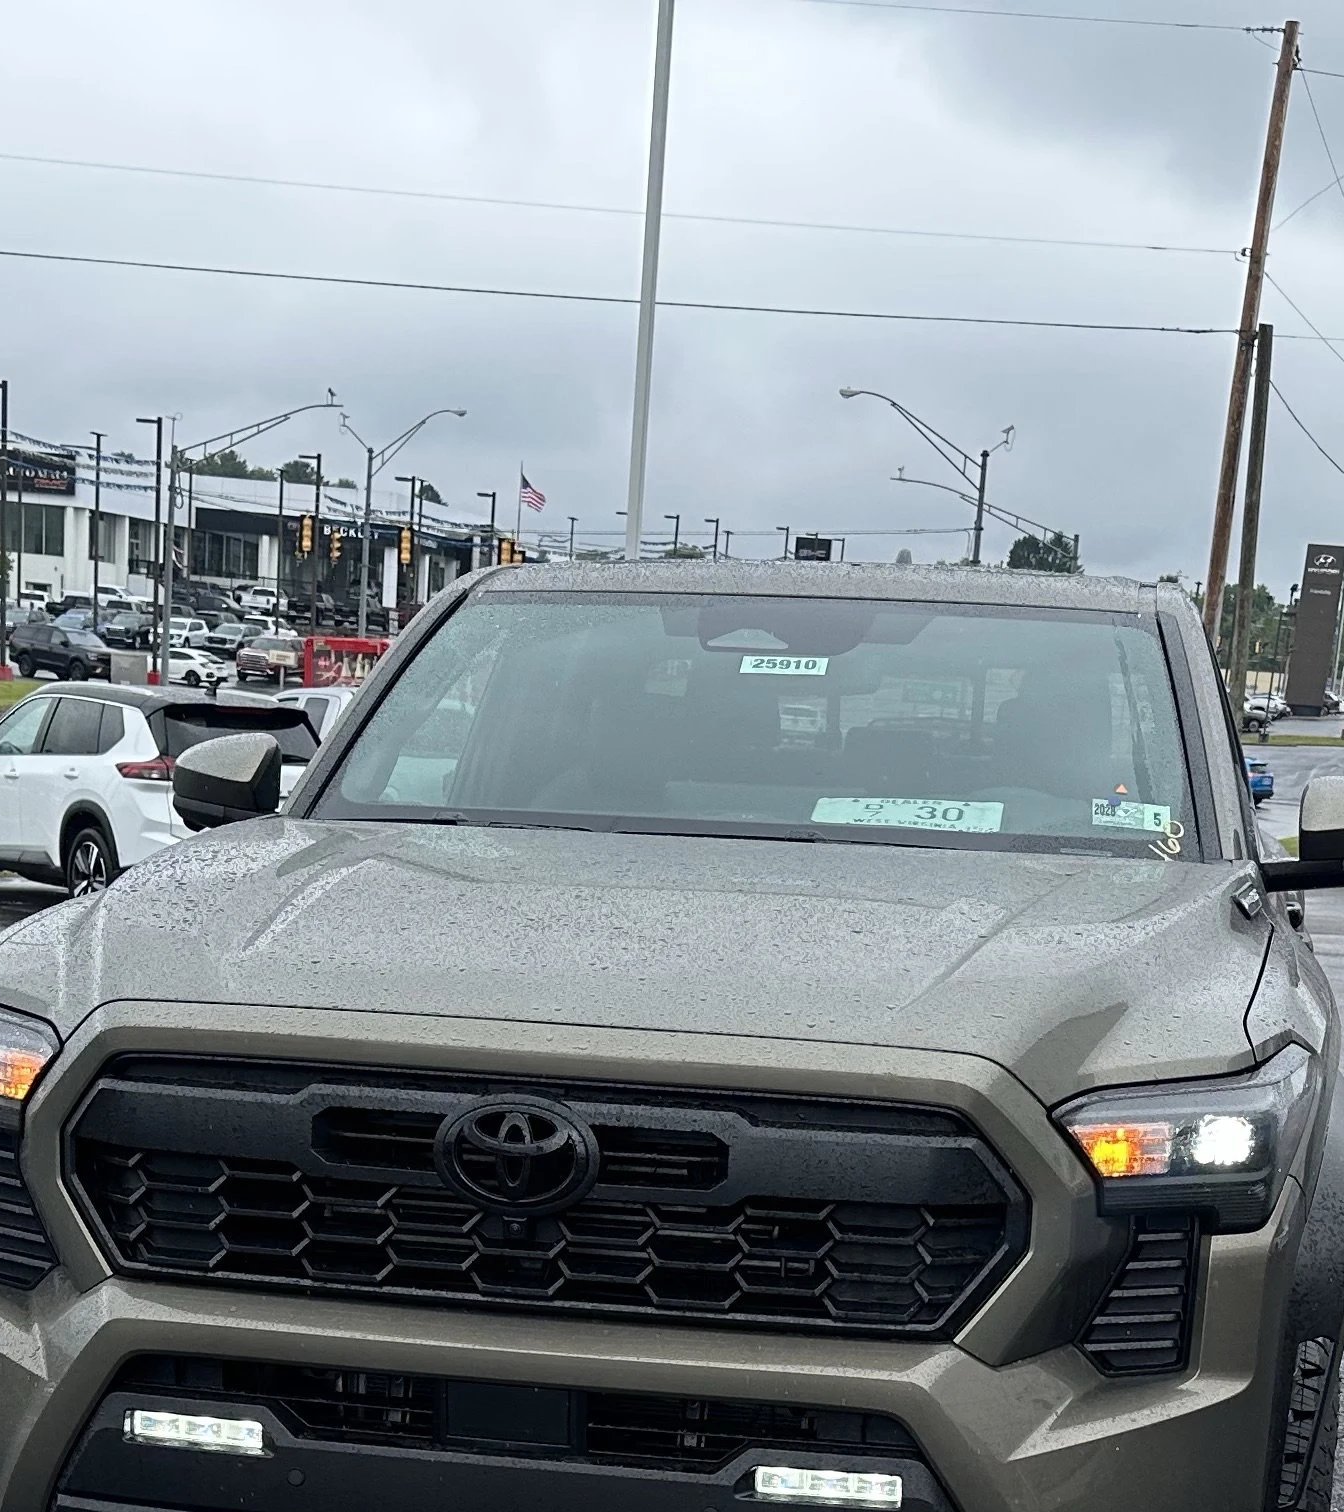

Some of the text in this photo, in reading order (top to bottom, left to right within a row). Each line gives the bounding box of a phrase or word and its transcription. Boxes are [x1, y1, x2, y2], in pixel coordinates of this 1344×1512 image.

[323, 524, 378, 540] BECKLY
[752, 658, 817, 670] 25910
[915, 806, 964, 822] 30
[1153, 813, 1162, 827] 5
